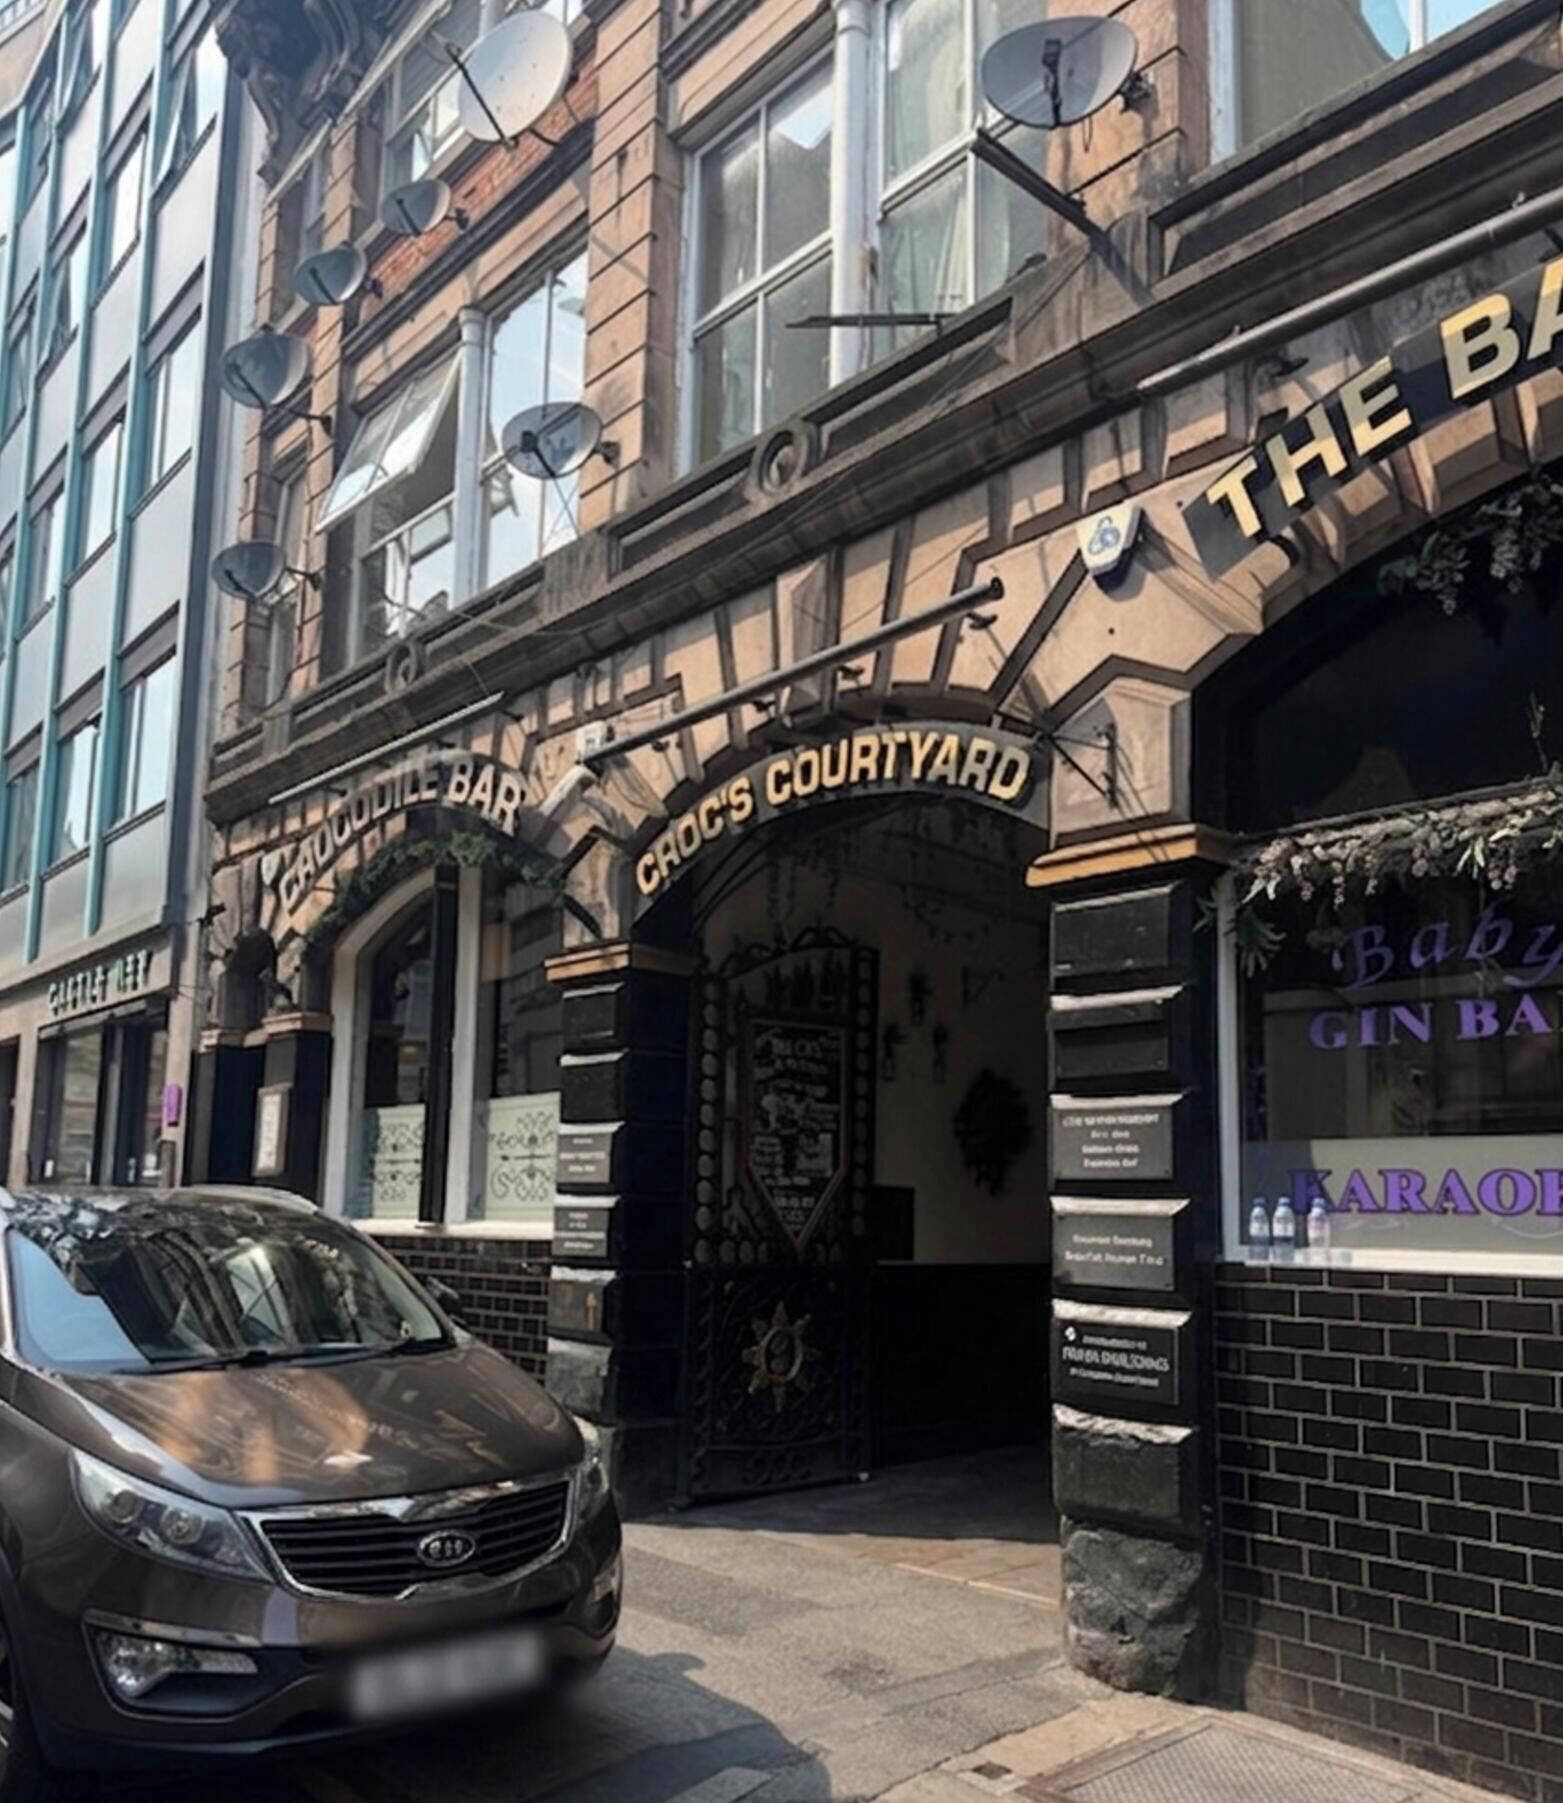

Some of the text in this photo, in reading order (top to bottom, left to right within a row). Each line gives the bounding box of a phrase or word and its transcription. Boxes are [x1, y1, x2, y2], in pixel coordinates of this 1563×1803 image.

[1206, 356, 1412, 538] THE
[447, 756, 525, 837] BAR
[635, 730, 1031, 896] CROC'S COURTYARD
[1308, 990, 1563, 1050] GIN BA
